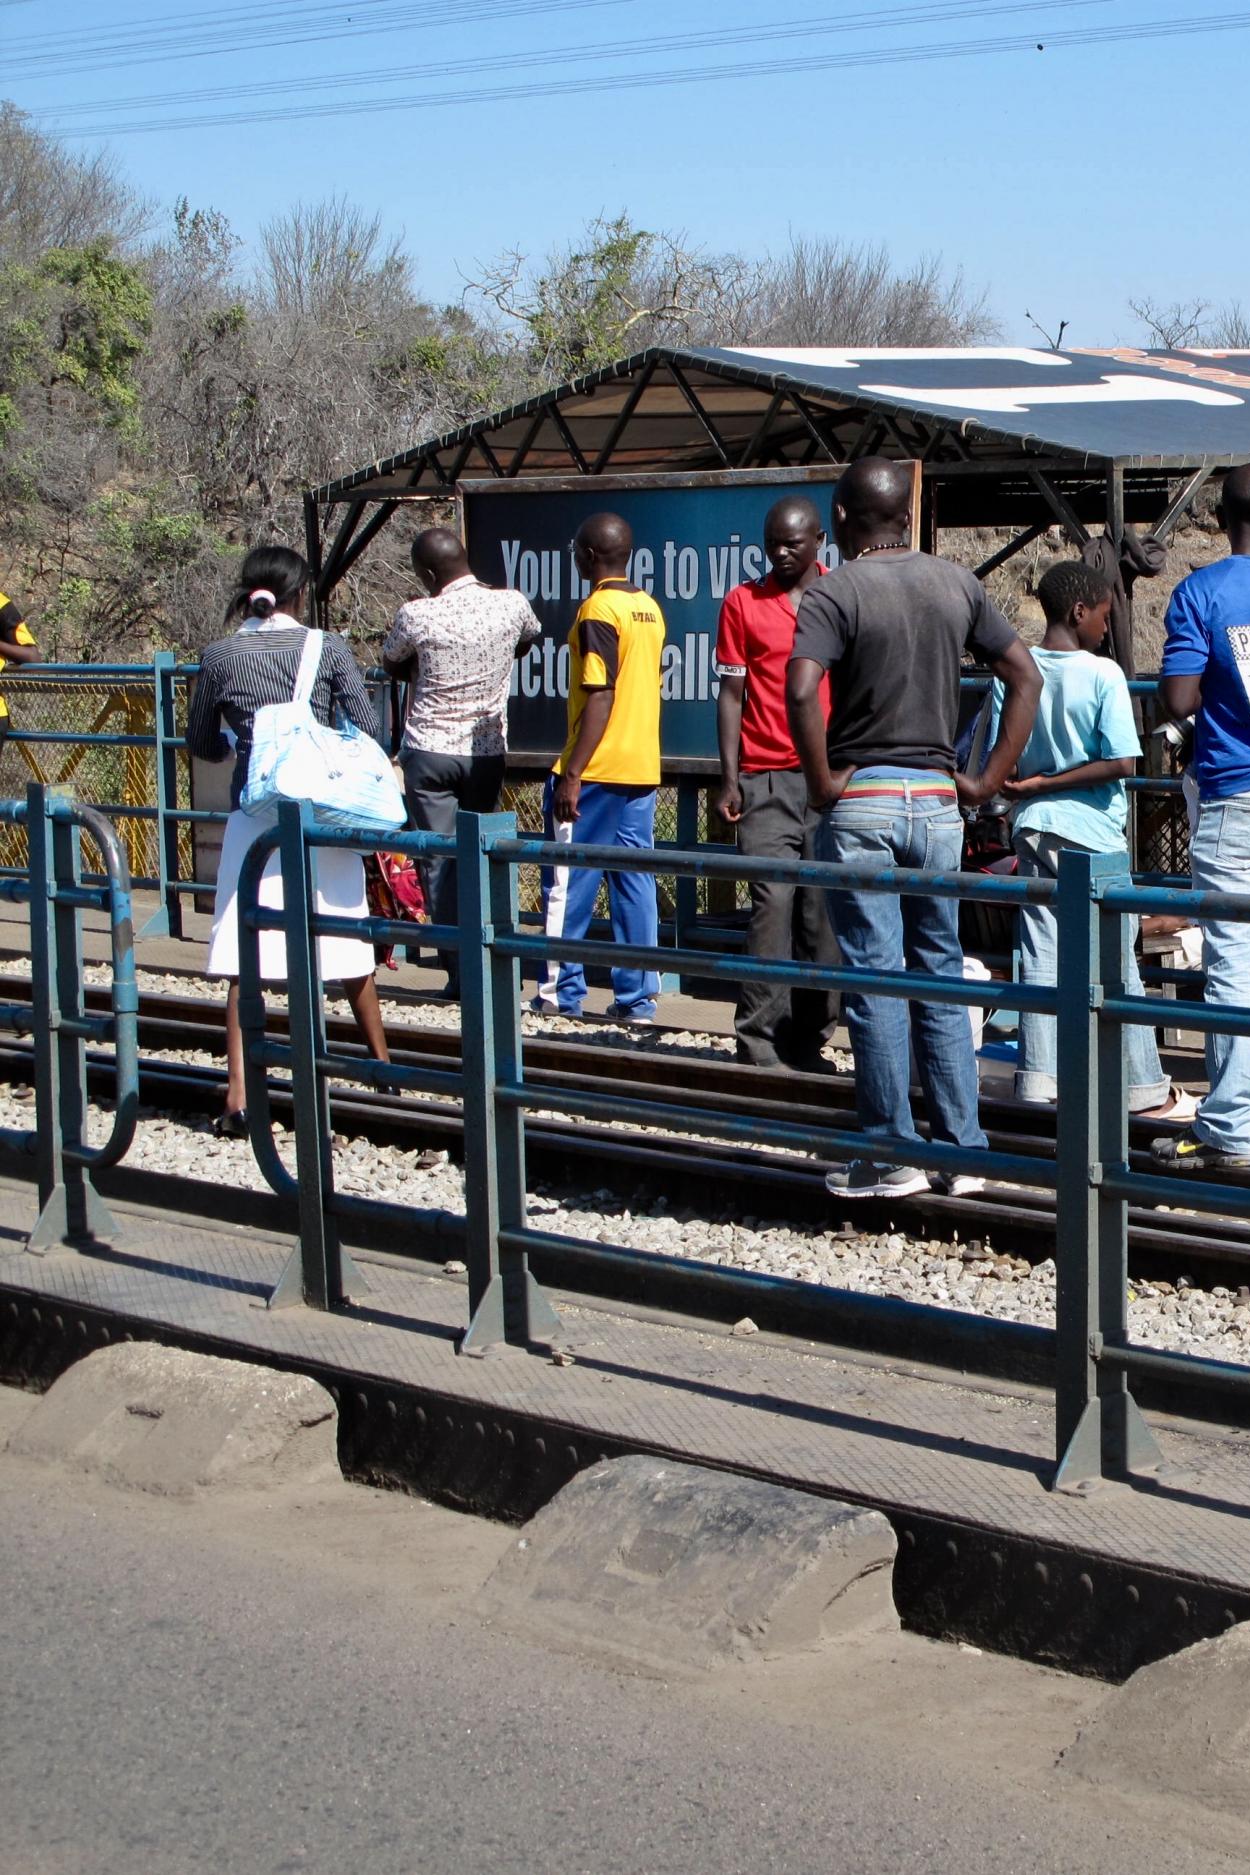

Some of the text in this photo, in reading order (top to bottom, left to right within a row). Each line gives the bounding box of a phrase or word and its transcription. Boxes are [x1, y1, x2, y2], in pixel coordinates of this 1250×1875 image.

[501, 540, 561, 600] You
[664, 540, 699, 599] to
[708, 534, 774, 599] vis
[659, 632, 721, 701] all
